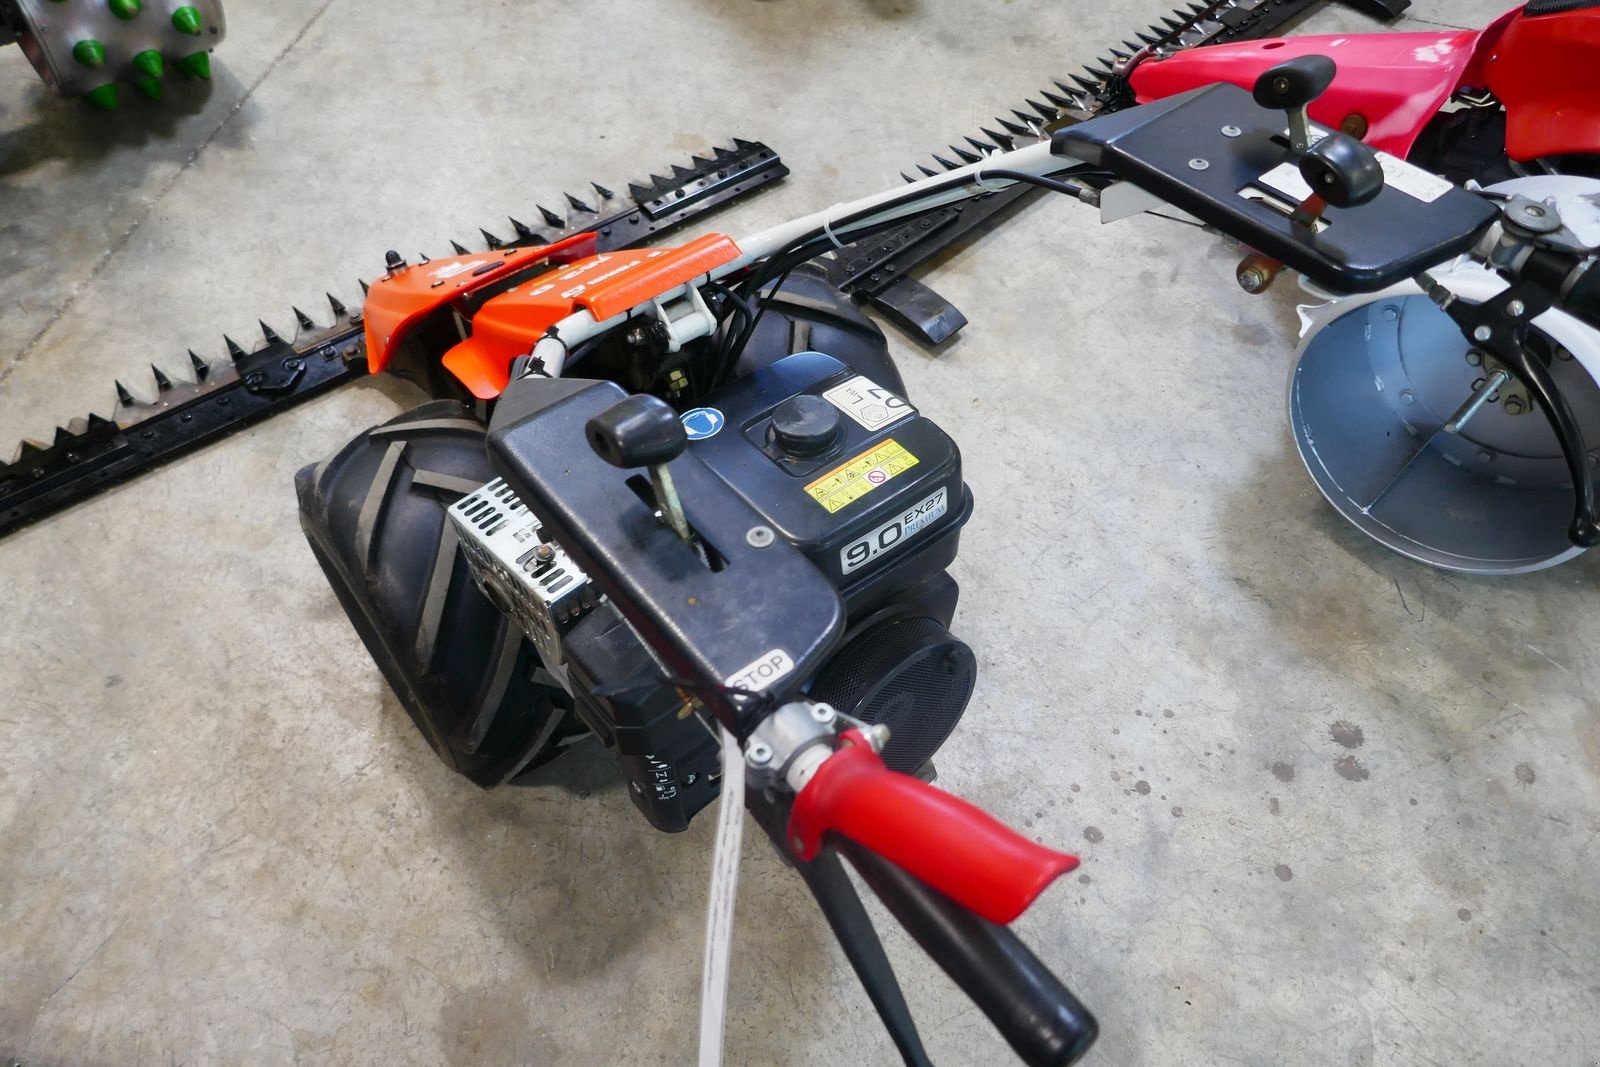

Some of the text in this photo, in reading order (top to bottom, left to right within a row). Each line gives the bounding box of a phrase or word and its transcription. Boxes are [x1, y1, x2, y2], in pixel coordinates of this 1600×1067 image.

[904, 491, 943, 525] EX27
[904, 505, 945, 536] PREMIUM
[846, 522, 902, 567] 9.0
[732, 655, 783, 691] STOP
